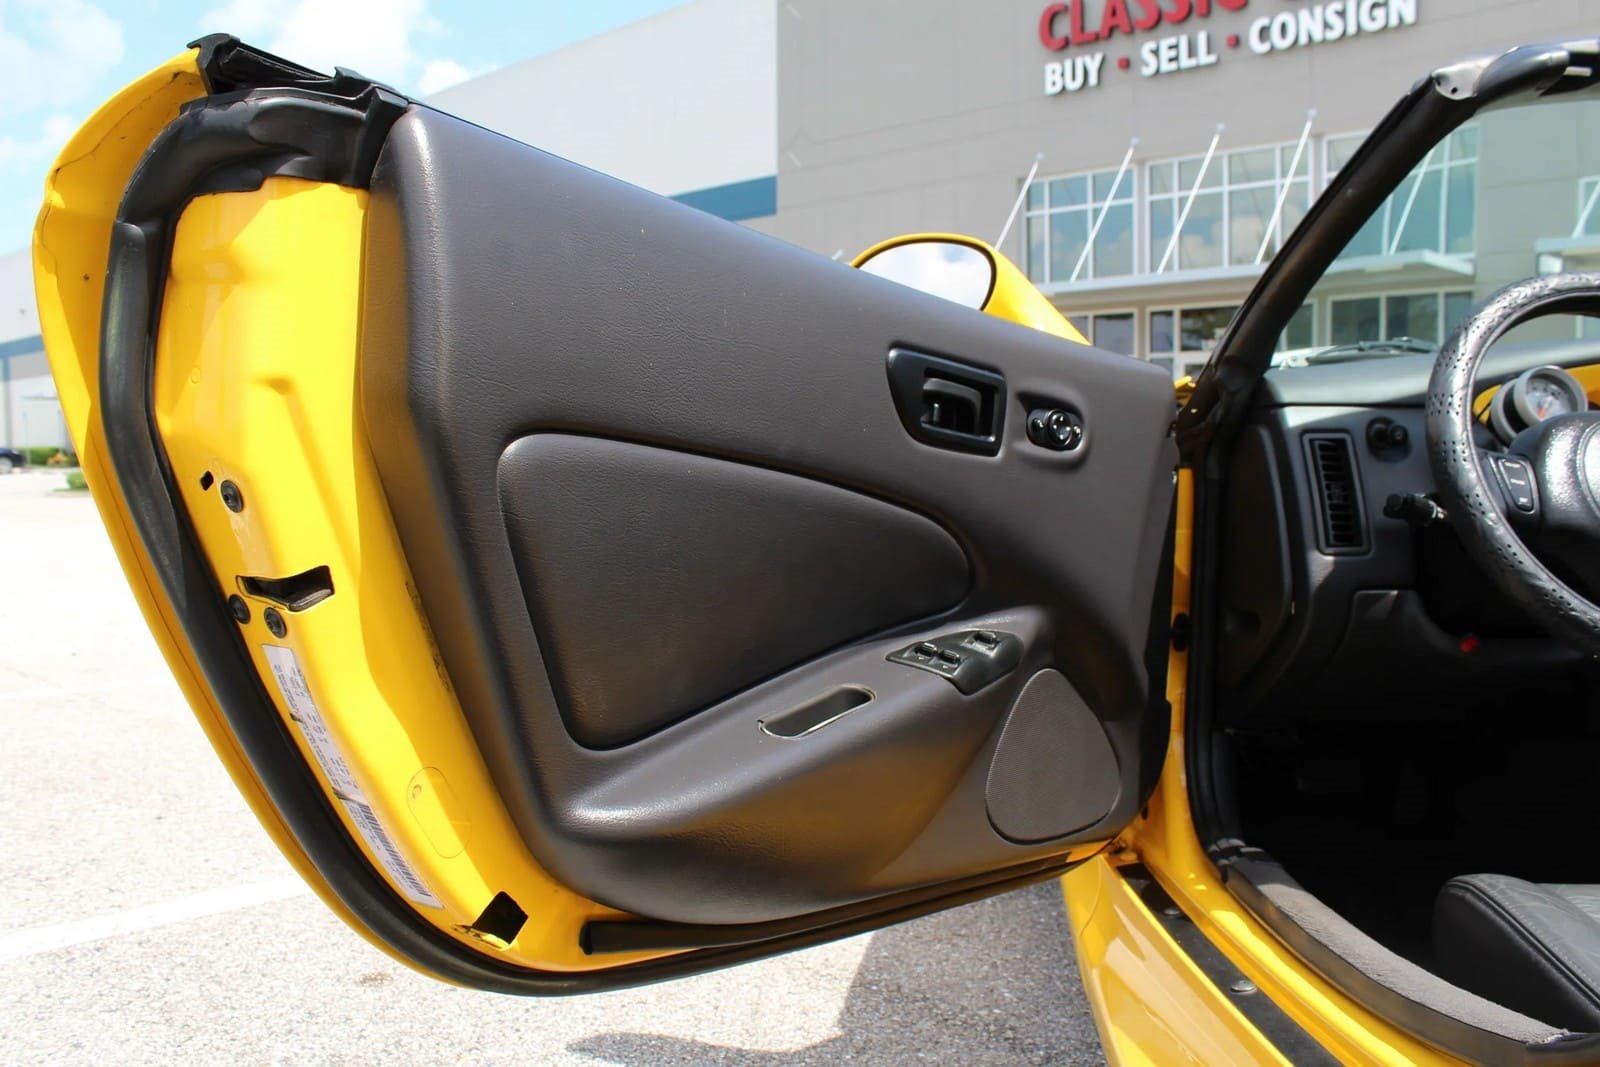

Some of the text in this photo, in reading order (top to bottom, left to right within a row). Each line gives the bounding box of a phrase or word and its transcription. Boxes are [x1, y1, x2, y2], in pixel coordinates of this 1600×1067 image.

[1039, 0, 1248, 51] CLASS
[1044, 0, 1417, 95] BUY SELL CONSIGN
